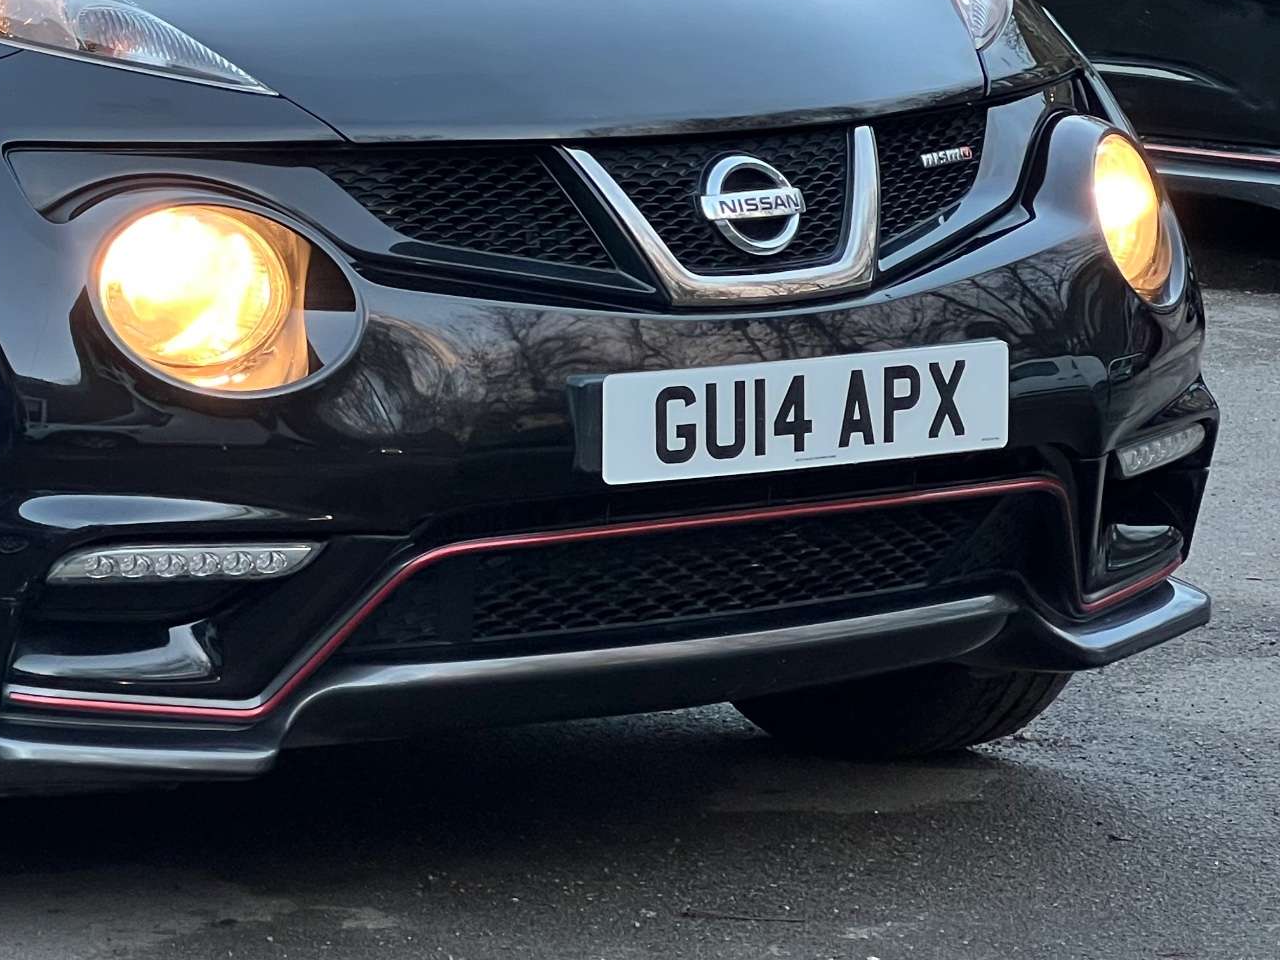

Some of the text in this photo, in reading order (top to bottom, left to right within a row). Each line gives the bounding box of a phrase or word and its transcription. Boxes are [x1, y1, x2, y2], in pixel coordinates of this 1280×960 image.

[719, 194, 799, 214] NISSAN
[655, 359, 966, 465] GU14 APX
